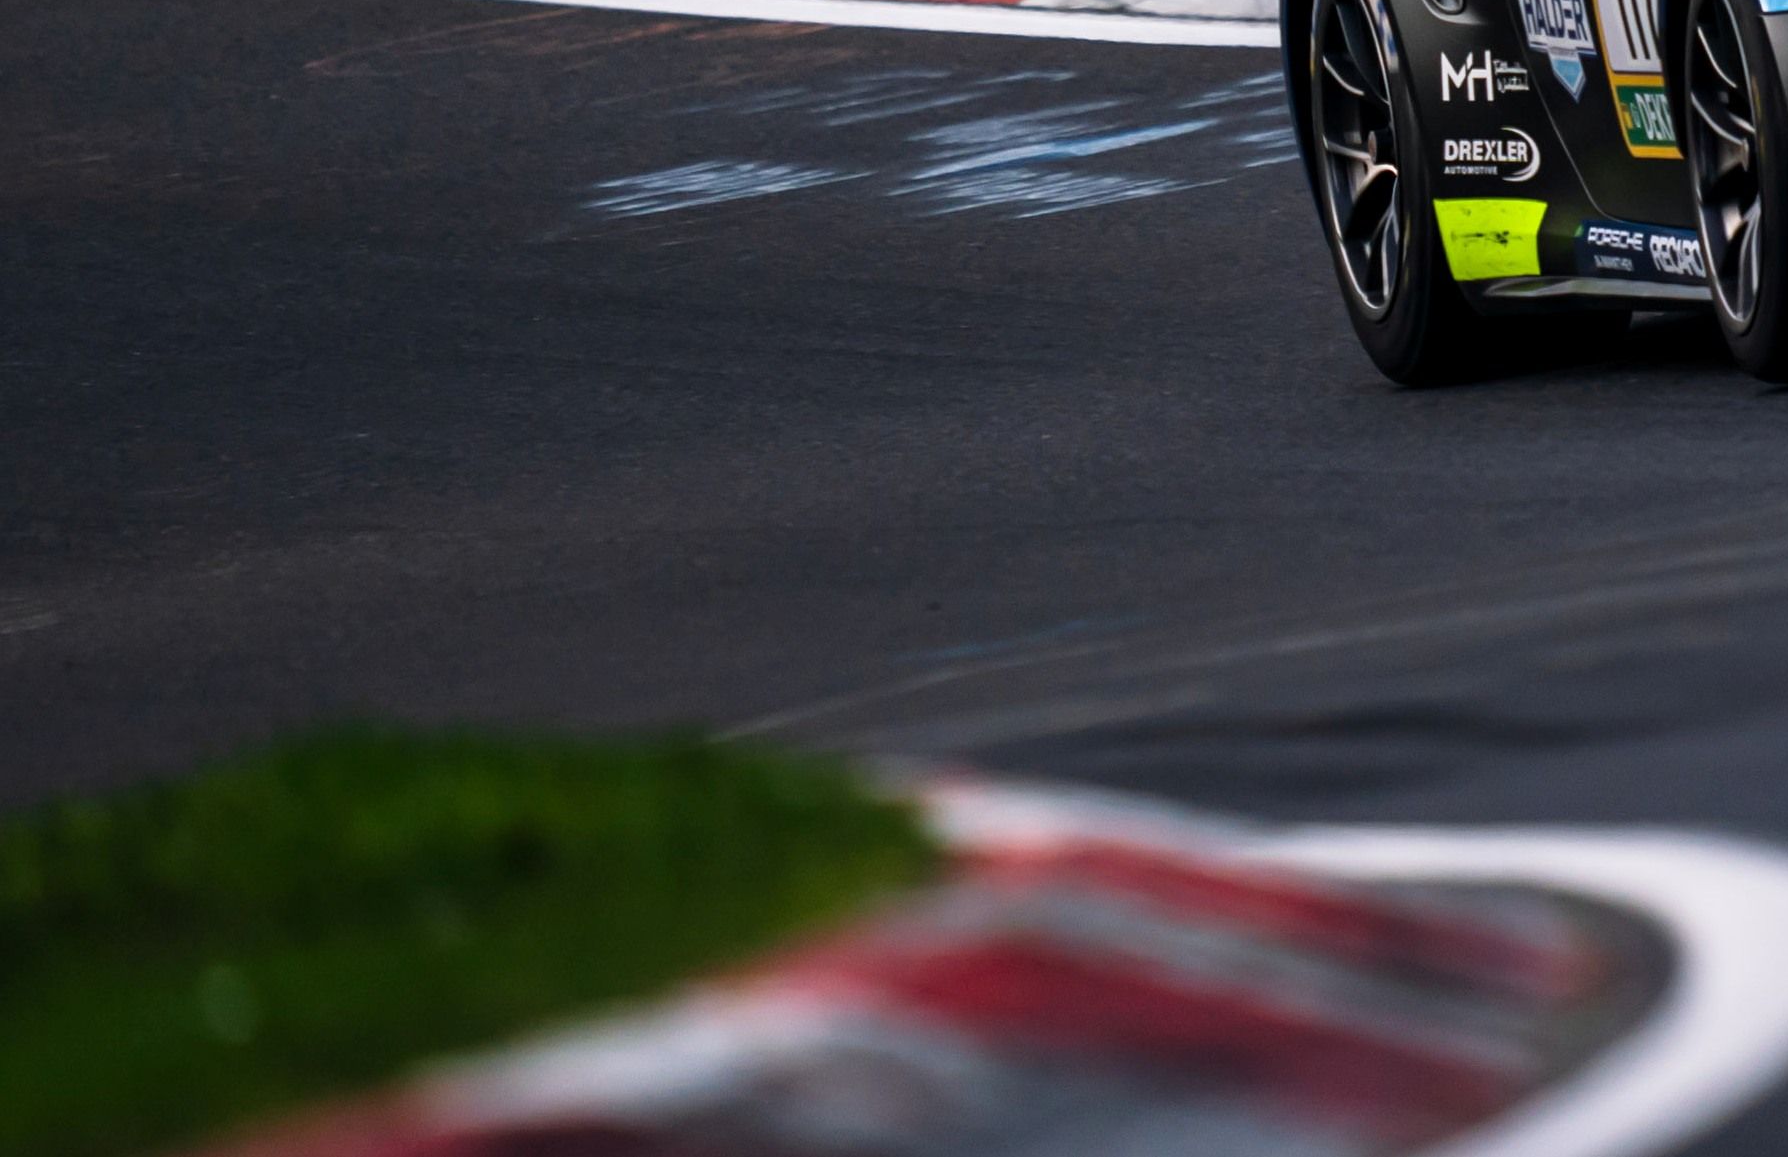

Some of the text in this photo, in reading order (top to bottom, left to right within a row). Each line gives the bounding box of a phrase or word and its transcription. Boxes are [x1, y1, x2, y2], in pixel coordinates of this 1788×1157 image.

[1444, 139, 1528, 162] DREXLER
[1444, 165, 1498, 175] AUTOMOTIVE
[1587, 226, 1644, 251] PORSCHE
[1649, 234, 1707, 278] RECARO
